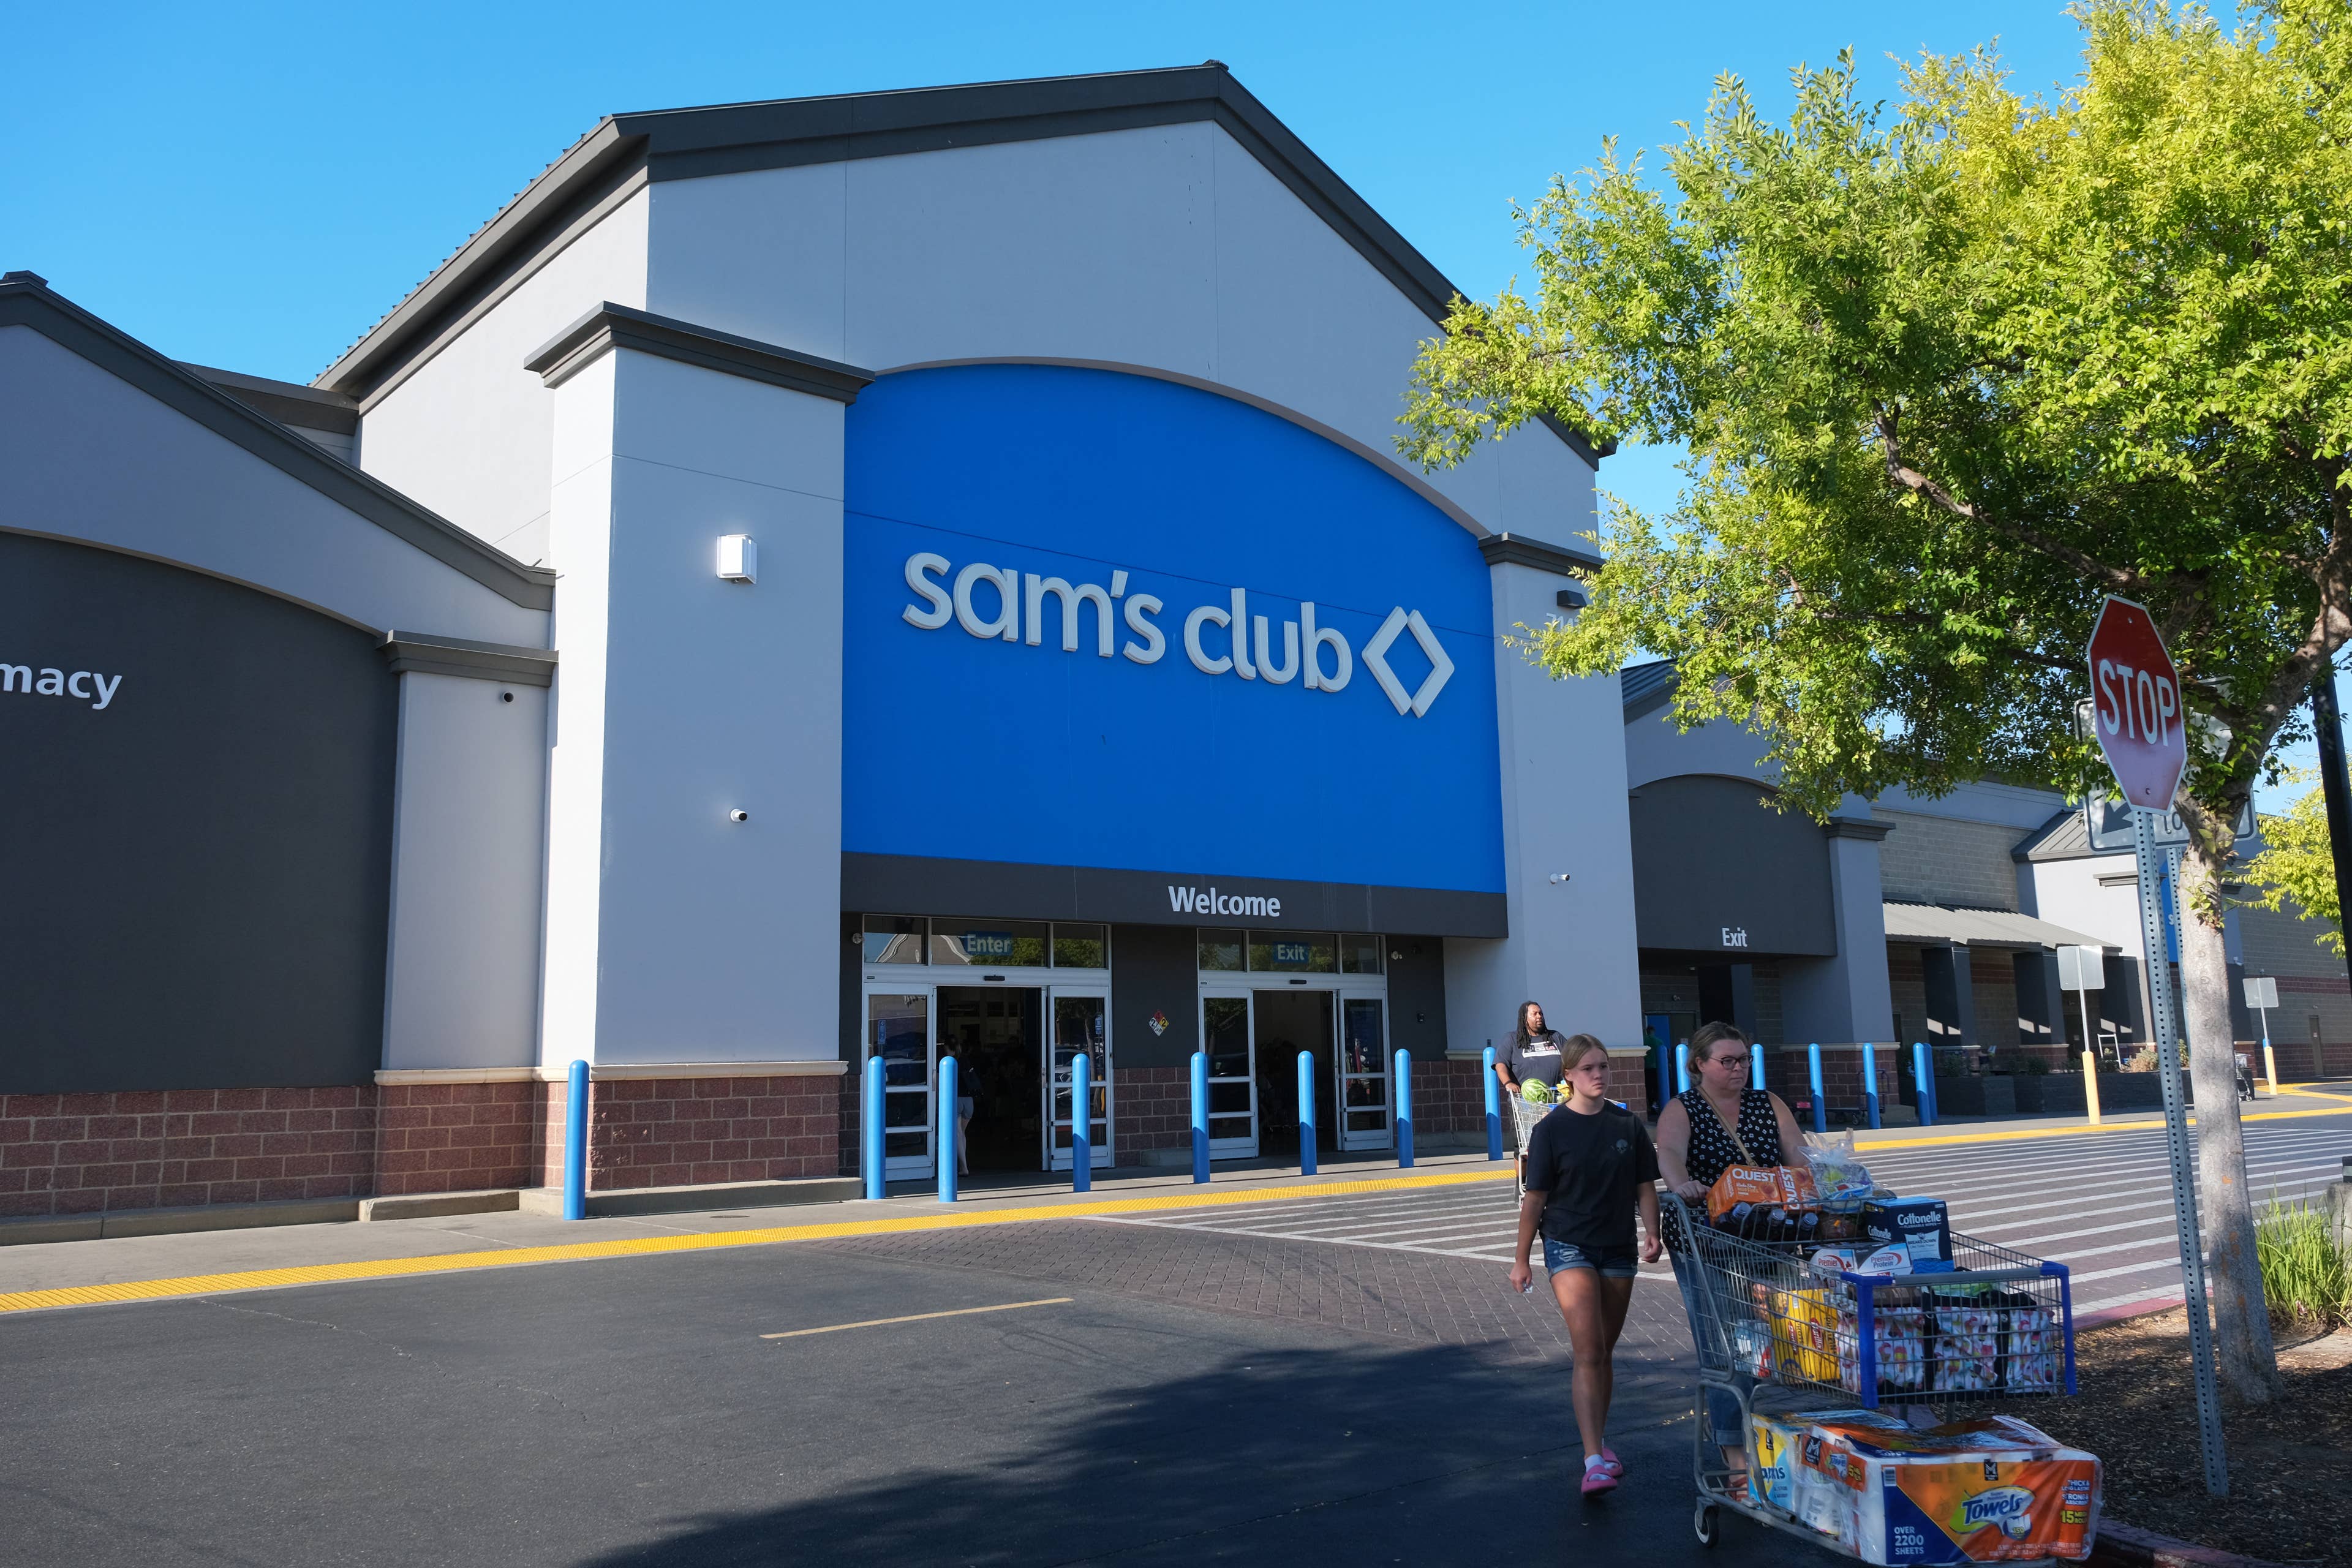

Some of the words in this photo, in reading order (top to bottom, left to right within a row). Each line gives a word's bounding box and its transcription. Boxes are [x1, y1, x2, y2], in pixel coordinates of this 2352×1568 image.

[902, 552, 1166, 665] sam's
[1183, 587, 1353, 693] club
[0, 663, 123, 710] macy
[2098, 659, 2176, 747] STOP
[1168, 886, 1281, 917] Welcome
[967, 933, 1012, 954] Enter
[1722, 927, 1747, 947] Exit
[1277, 944, 1305, 961] Exit
[1732, 1167, 1776, 1182] QUEST
[1779, 1166, 1800, 1210] QUEST
[1898, 1211, 1941, 1225] Cottonelle
[1818, 1257, 1838, 1268] Premier
[1962, 1494, 2023, 1525] Towels
[2060, 1510, 2075, 1524] 15
[1894, 1535, 1924, 1546] 2200
